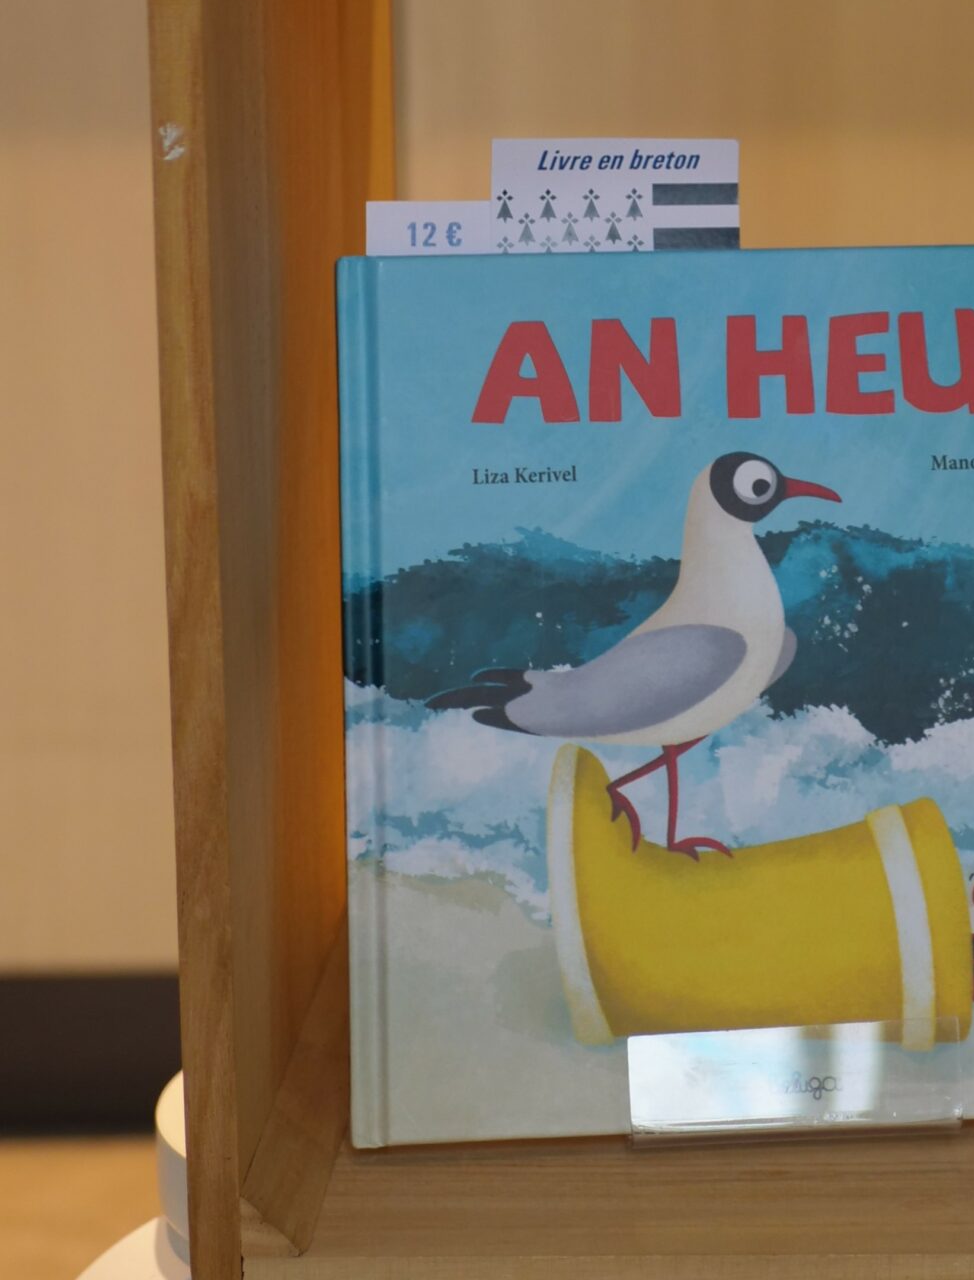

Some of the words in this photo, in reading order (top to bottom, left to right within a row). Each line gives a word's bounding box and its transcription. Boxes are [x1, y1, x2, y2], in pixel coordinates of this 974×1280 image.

[537, 150, 591, 171] Livre
[597, 154, 623, 170] en
[630, 150, 701, 170] breton
[406, 222, 438, 248] 12
[445, 222, 463, 248] €
[471, 317, 682, 425] AN
[472, 468, 510, 485] Liza
[514, 465, 577, 484] Kerivel
[777, 1070, 844, 1101] luga
